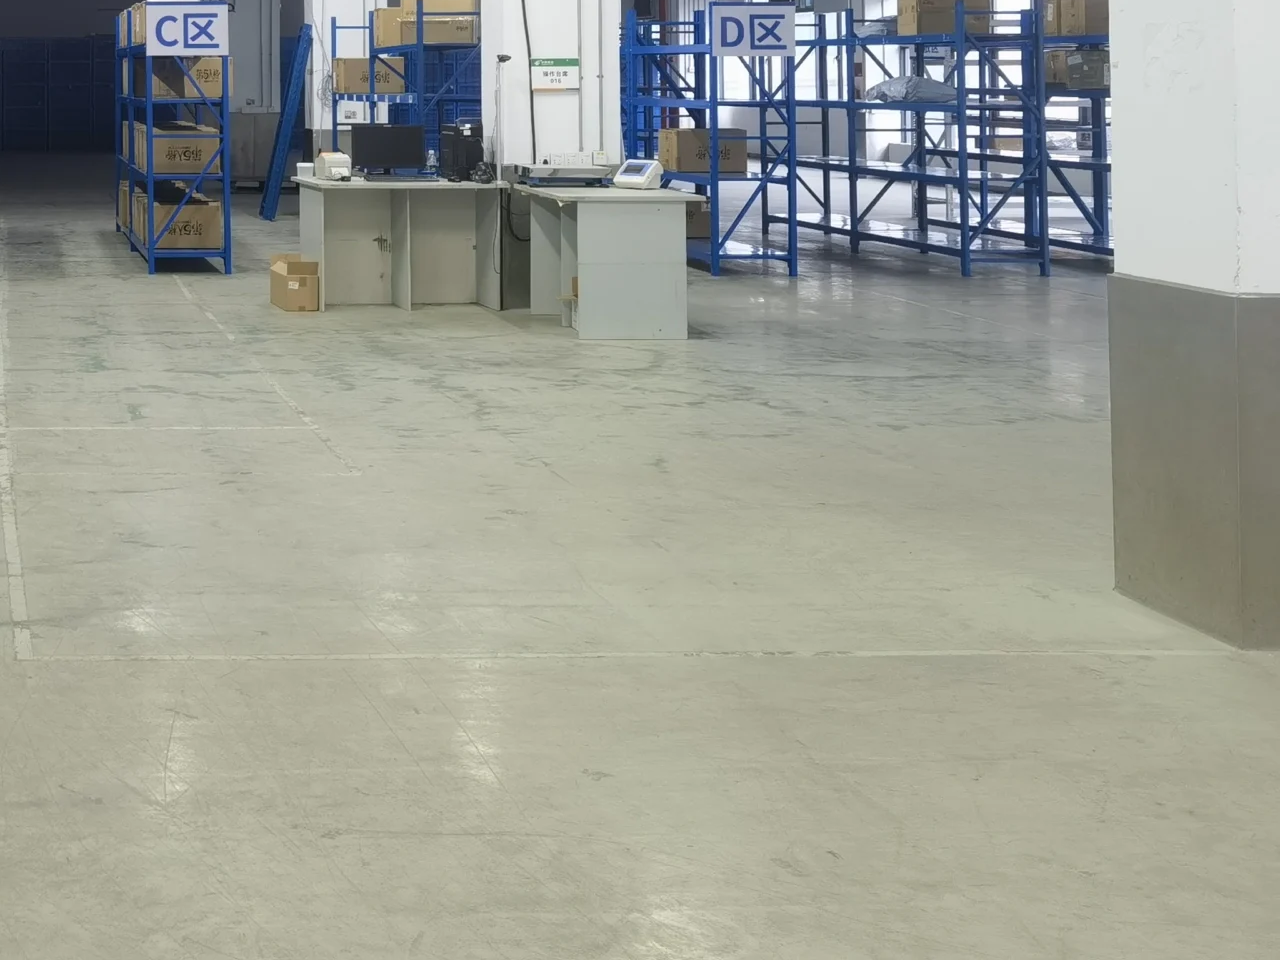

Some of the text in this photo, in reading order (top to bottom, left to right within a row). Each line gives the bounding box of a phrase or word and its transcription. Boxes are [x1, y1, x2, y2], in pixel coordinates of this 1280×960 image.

[155, 12, 220, 49] C区
[720, 13, 788, 50] D区
[360, 69, 390, 84] 第5格
[165, 146, 204, 162] 第5人格
